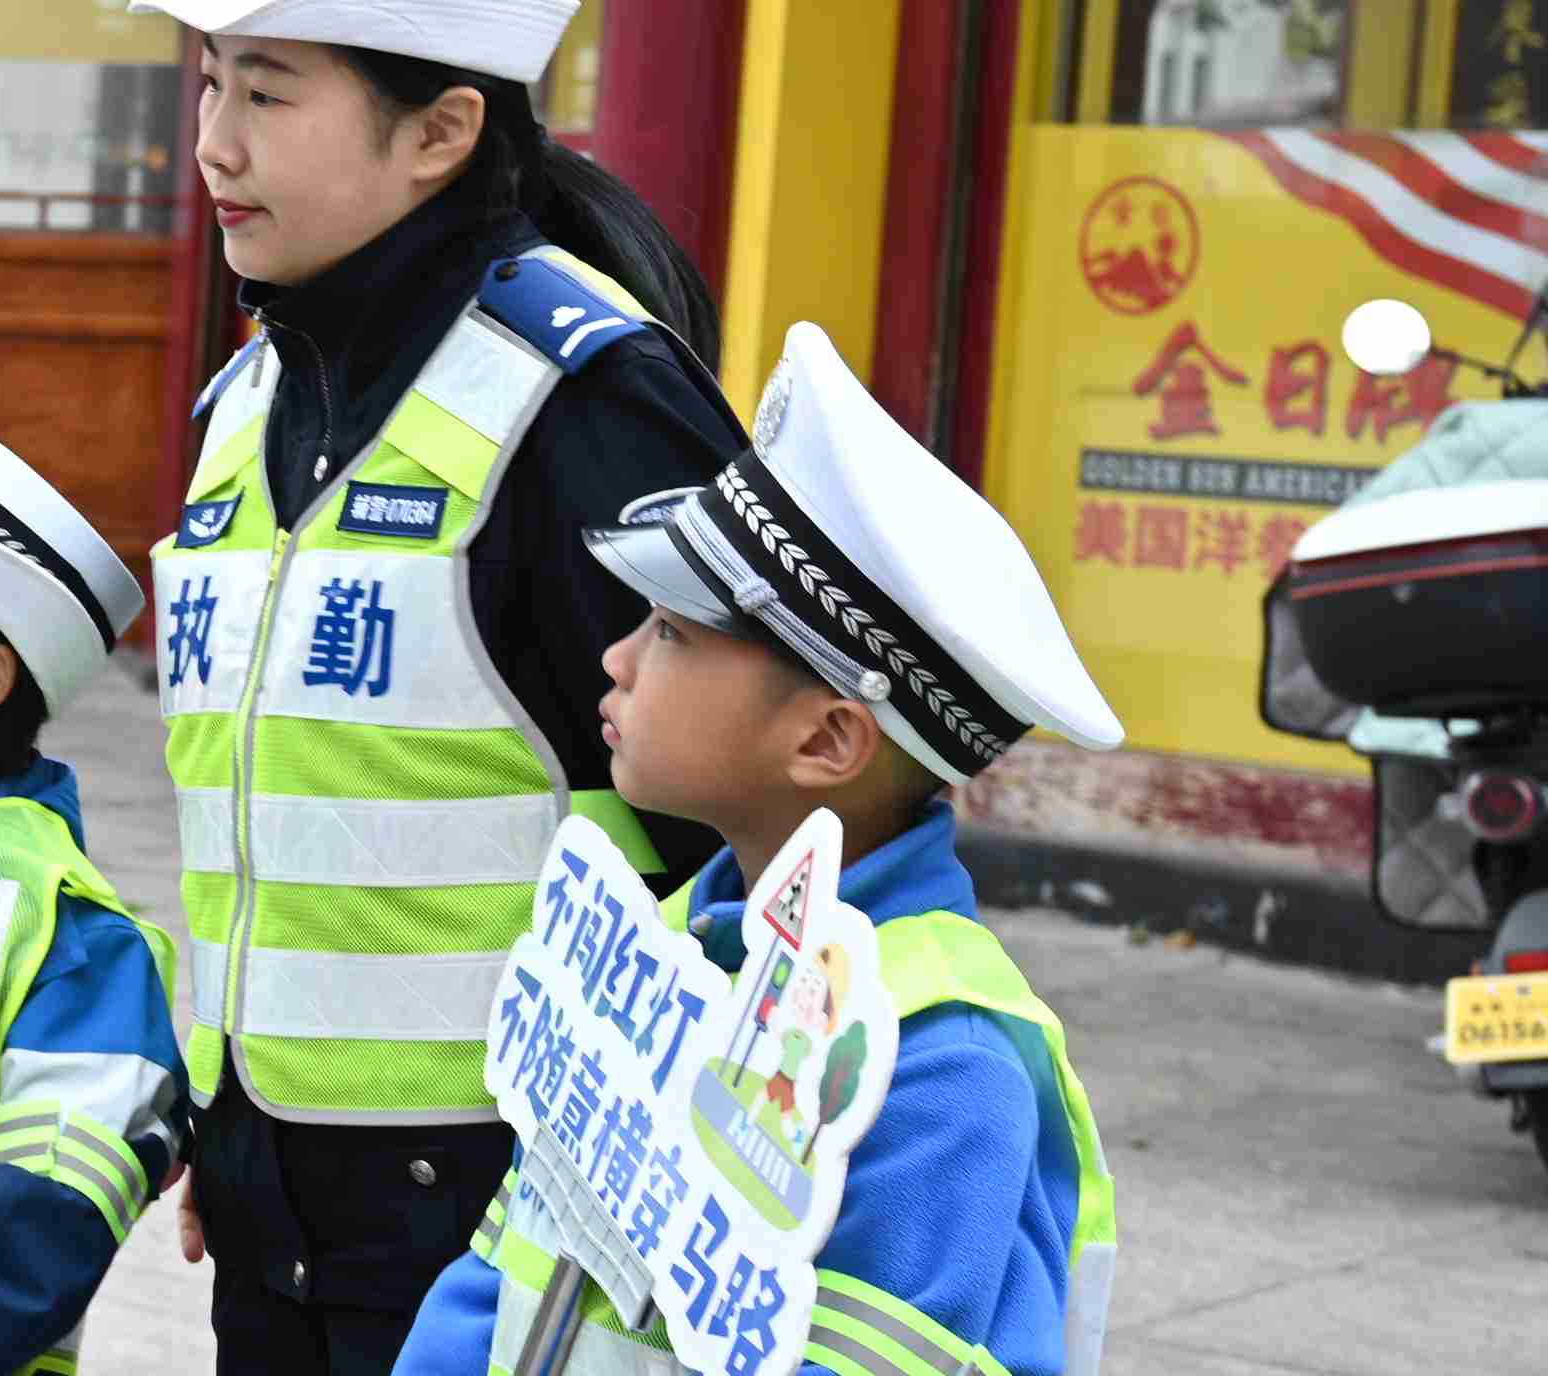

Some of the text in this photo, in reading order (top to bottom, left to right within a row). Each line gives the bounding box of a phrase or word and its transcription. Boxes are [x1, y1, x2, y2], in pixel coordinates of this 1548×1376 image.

[167, 575, 395, 697] 执勤
[541, 847, 707, 1095] 不闯红灯
